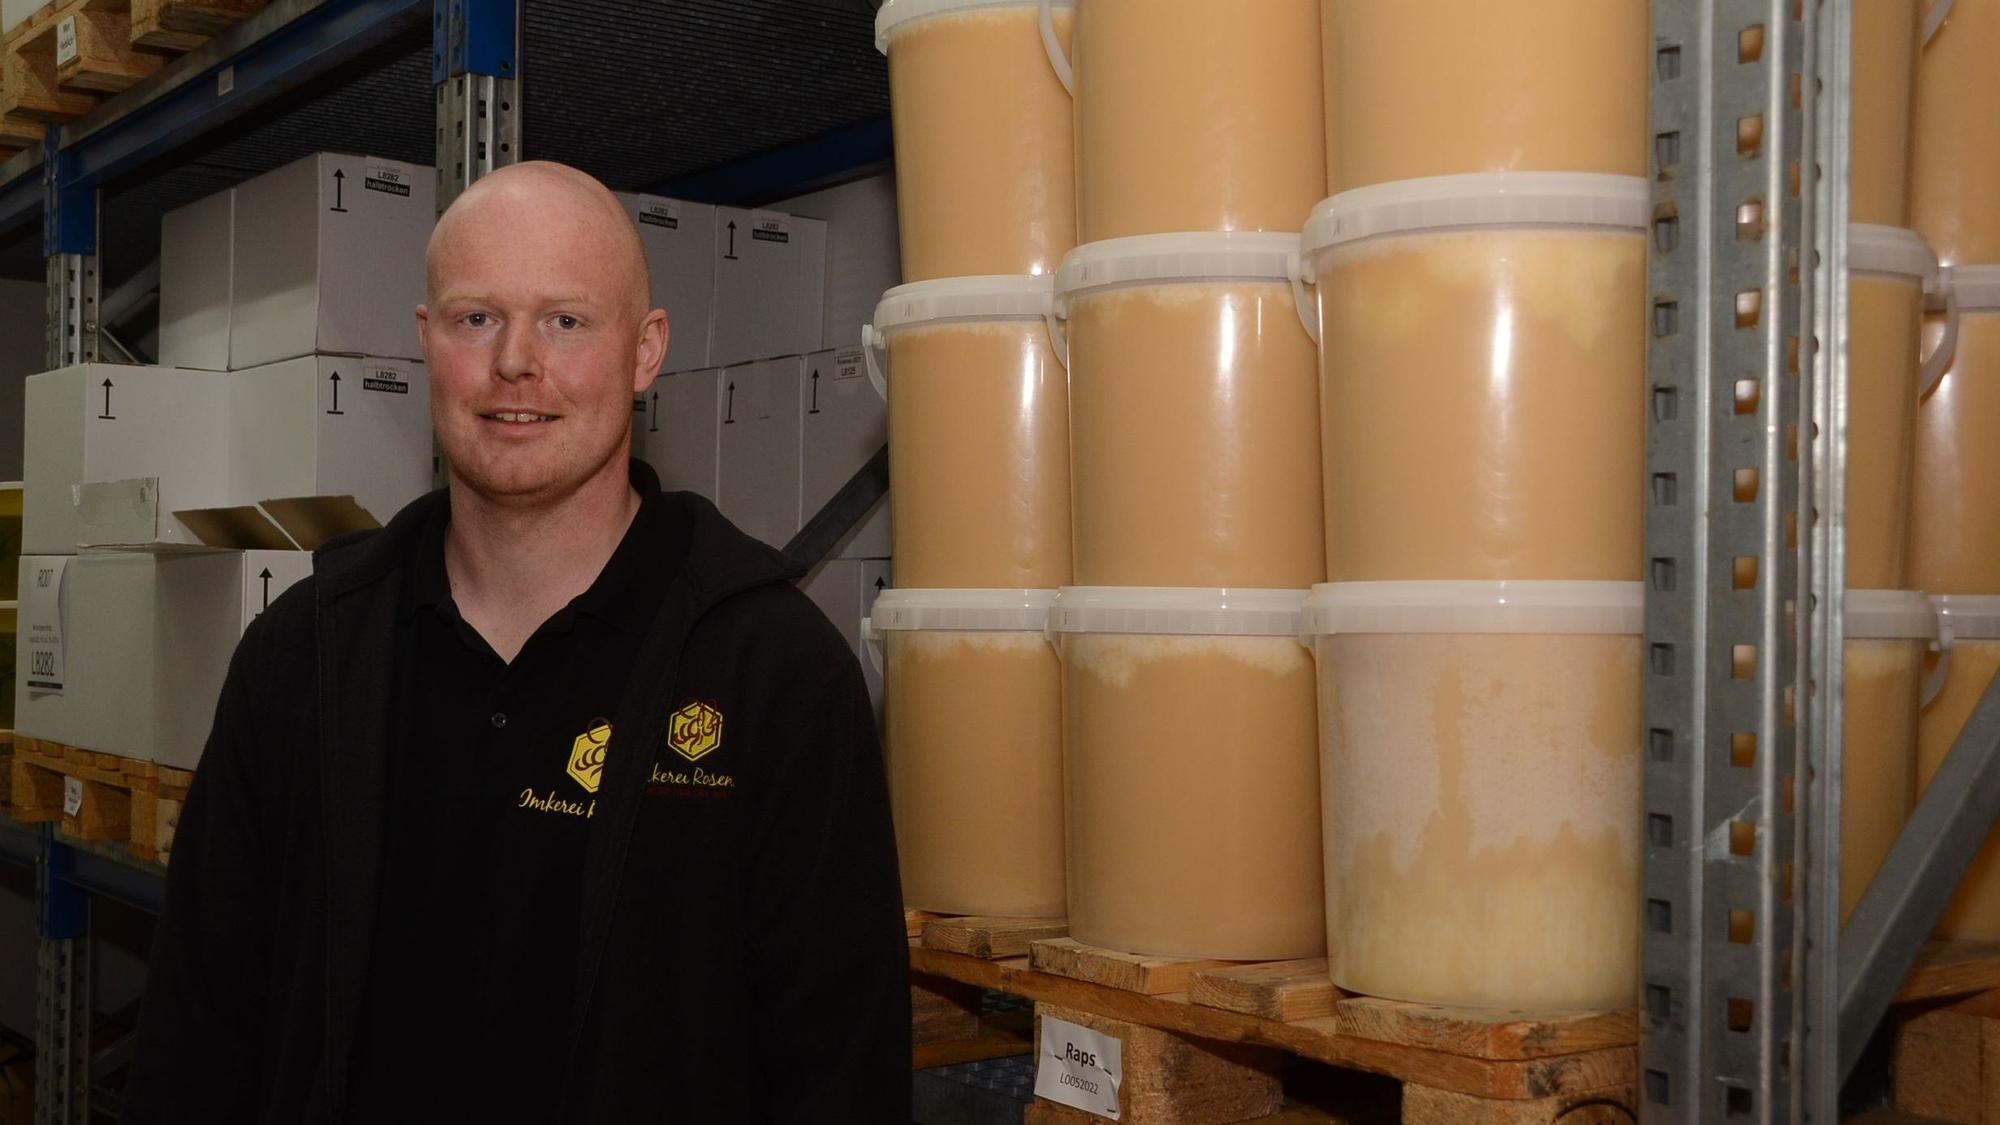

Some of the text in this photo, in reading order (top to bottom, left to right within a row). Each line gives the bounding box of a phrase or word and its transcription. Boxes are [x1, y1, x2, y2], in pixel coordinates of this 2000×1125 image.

[366, 179, 408, 195] halbtrocken
[365, 380, 407, 393] halbtrocken
[31, 650, 55, 677] L8282
[517, 787, 586, 816] Imkerei
[1065, 1042, 1097, 1068] Raps
